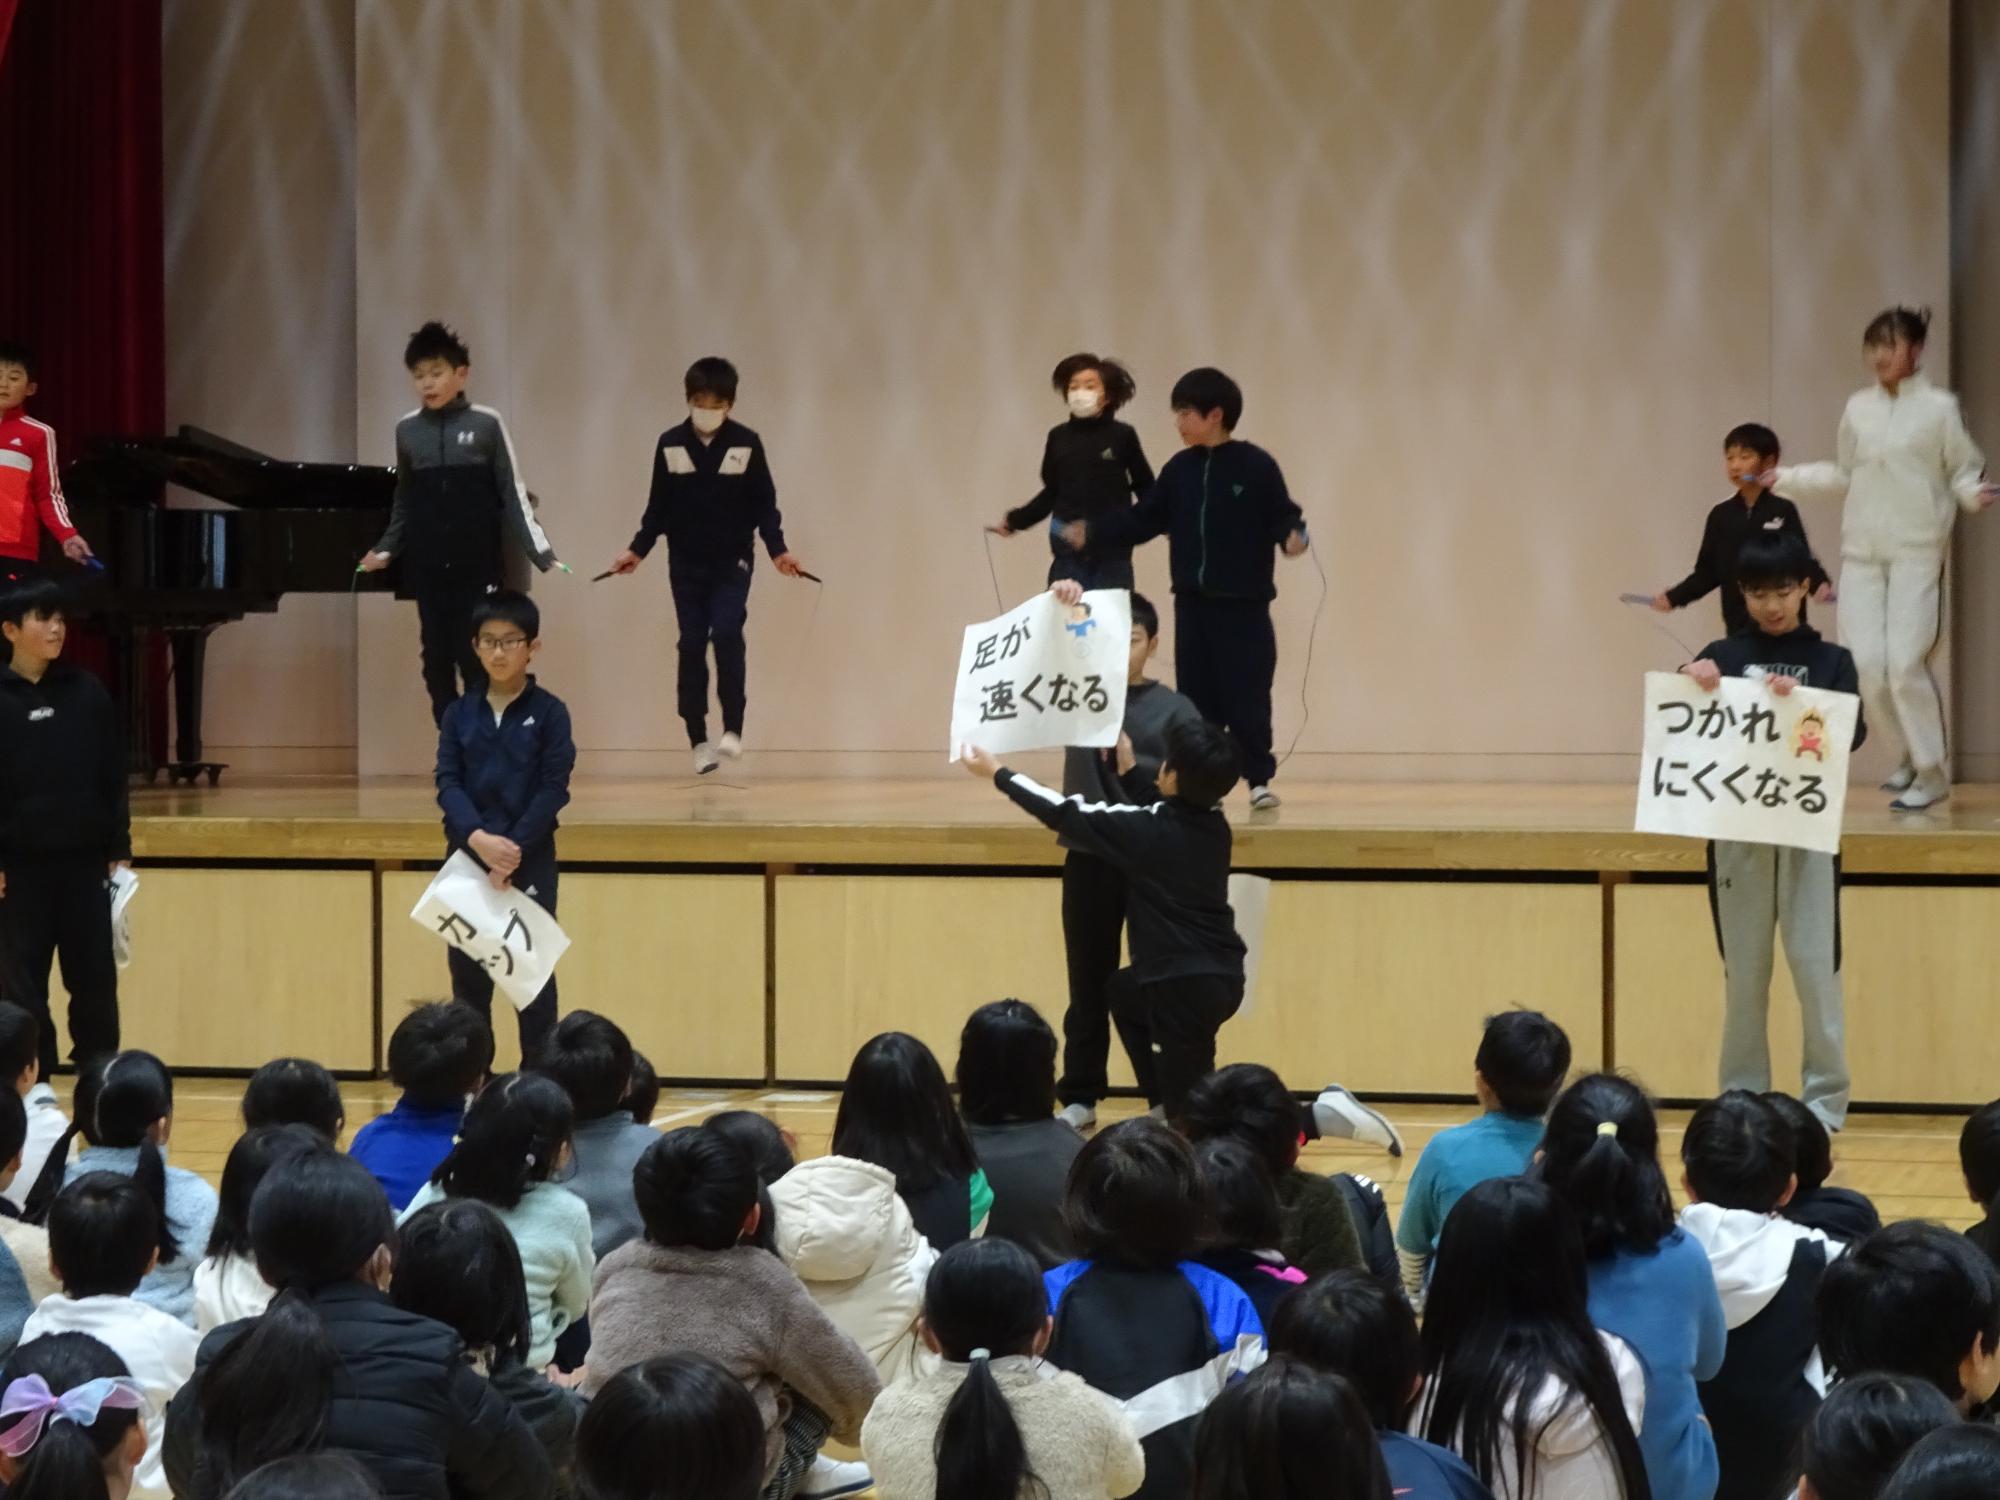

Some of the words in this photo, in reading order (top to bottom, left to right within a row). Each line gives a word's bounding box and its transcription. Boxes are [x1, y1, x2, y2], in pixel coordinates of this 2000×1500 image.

[969, 616, 1031, 675] 足が
[980, 673, 1110, 724] 速くなる
[1657, 700, 1781, 744] つかれ
[1653, 756, 1828, 814] にくくなる
